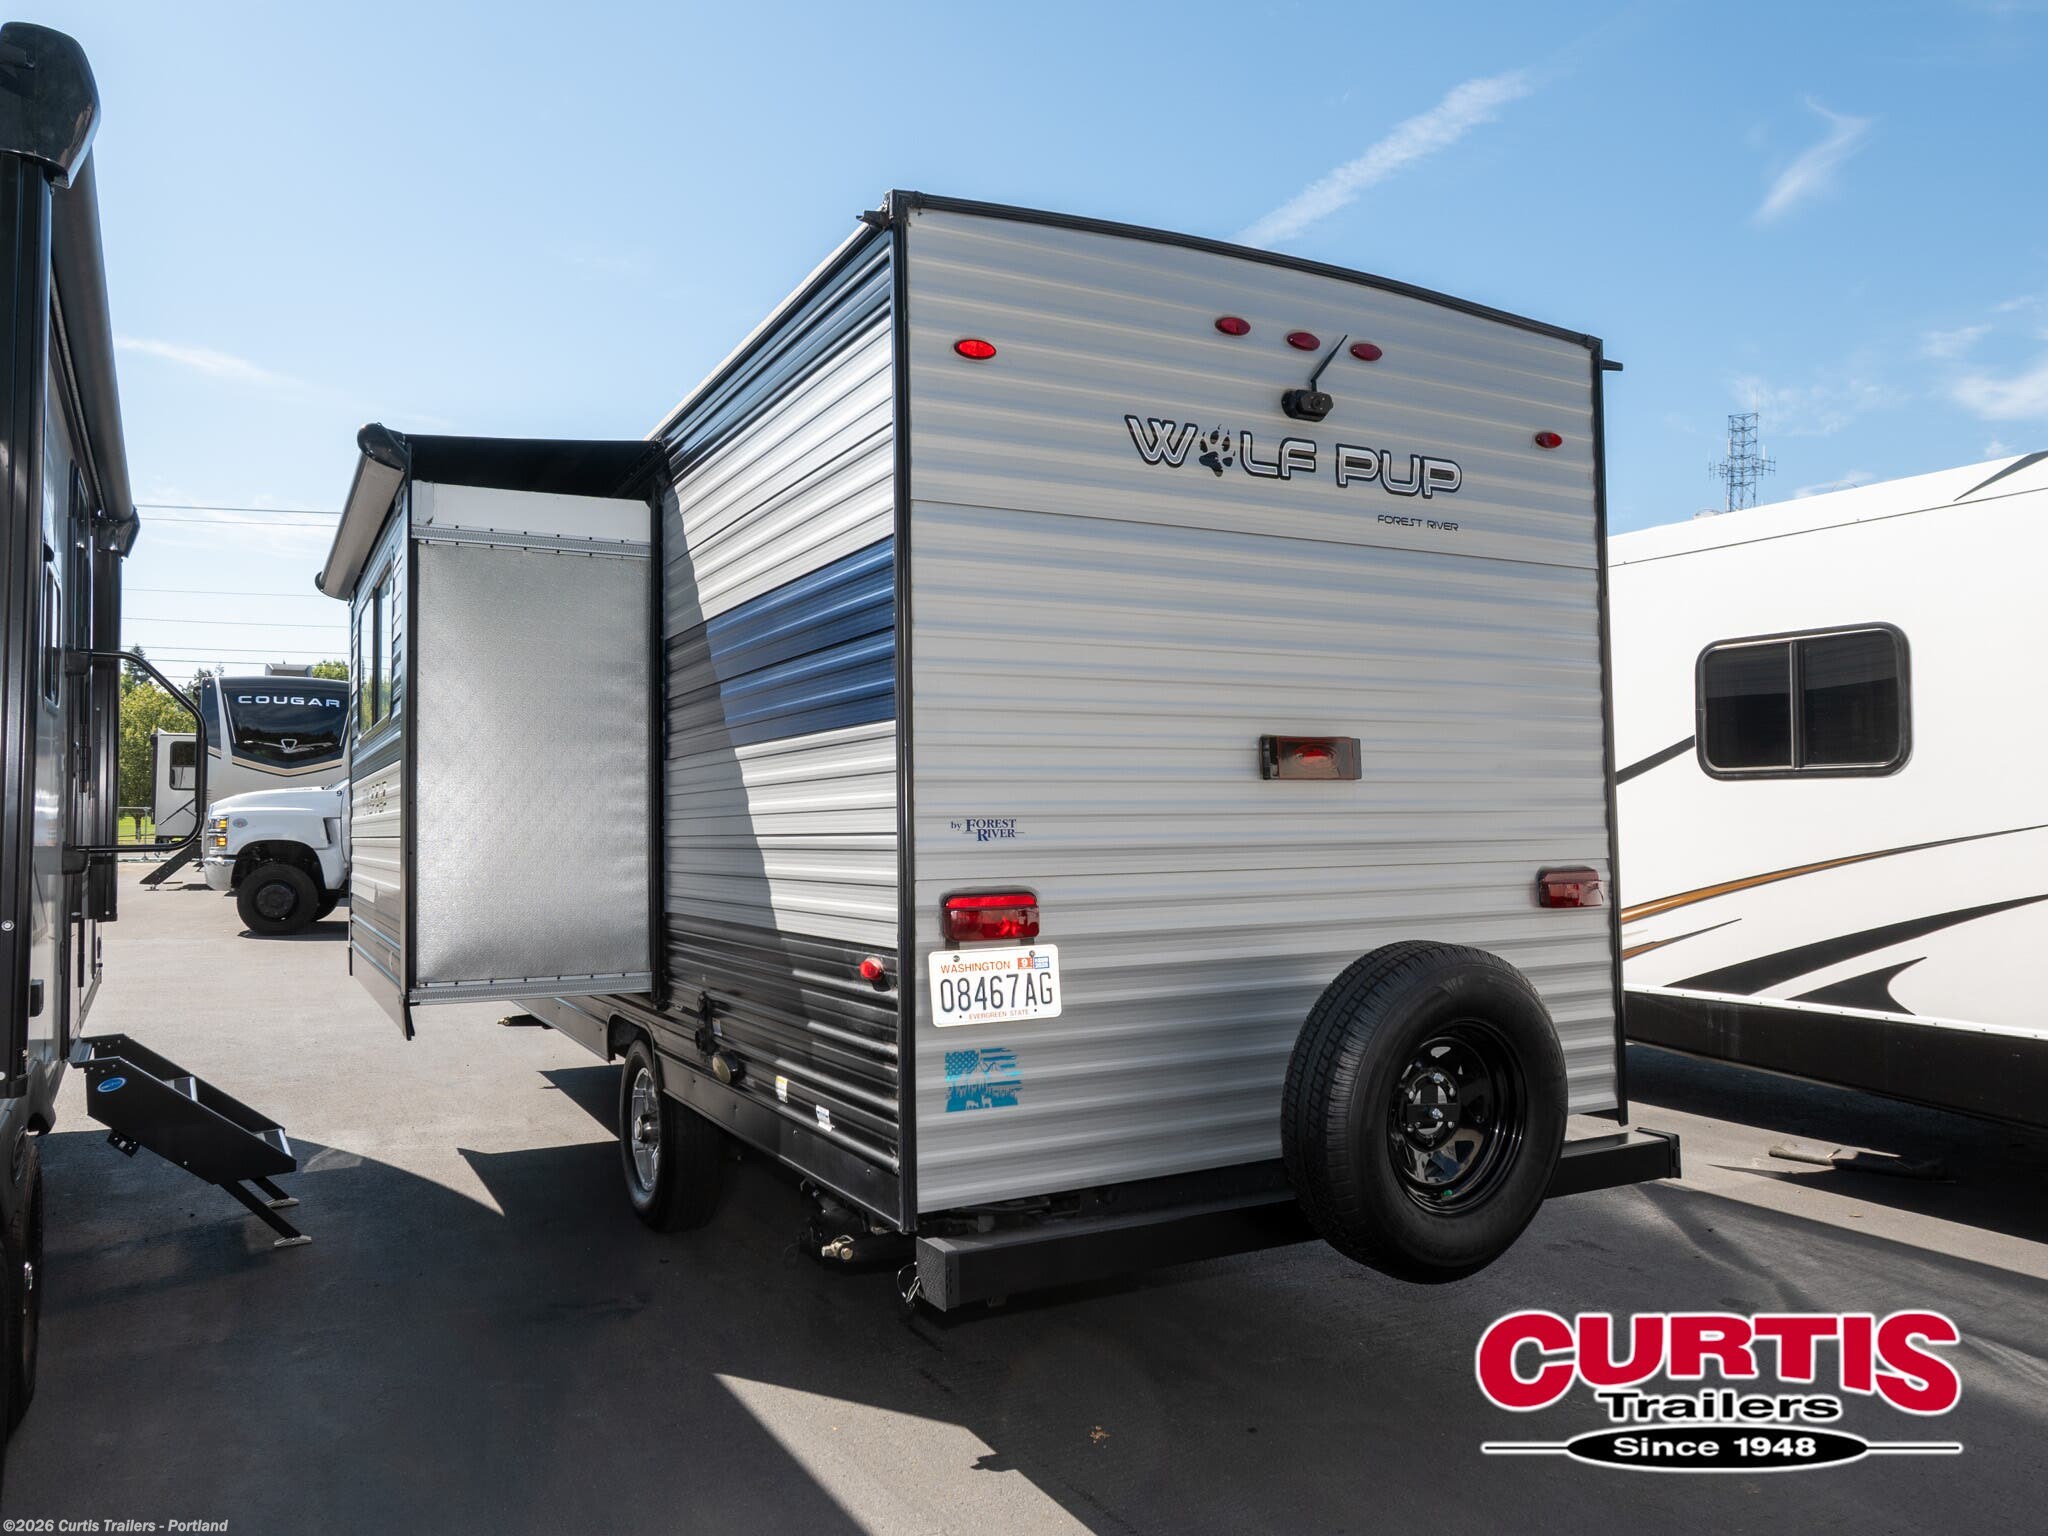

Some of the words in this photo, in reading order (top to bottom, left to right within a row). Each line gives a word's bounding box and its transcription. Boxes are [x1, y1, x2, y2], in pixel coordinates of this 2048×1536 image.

[1335, 443, 1463, 500] PUP
[1377, 514, 1423, 528] FOREST
[1427, 519, 1460, 532] RIVER
[237, 695, 341, 708] COUGAR
[950, 821, 962, 831] by
[966, 818, 1017, 832] FOREST
[977, 828, 1016, 841] RIVER
[940, 960, 1011, 974] WASHINGTON
[940, 971, 1053, 1013] 08467AG
[968, 1011, 1007, 1020] EVERGREEN
[1009, 1009, 1029, 1017] STATE
